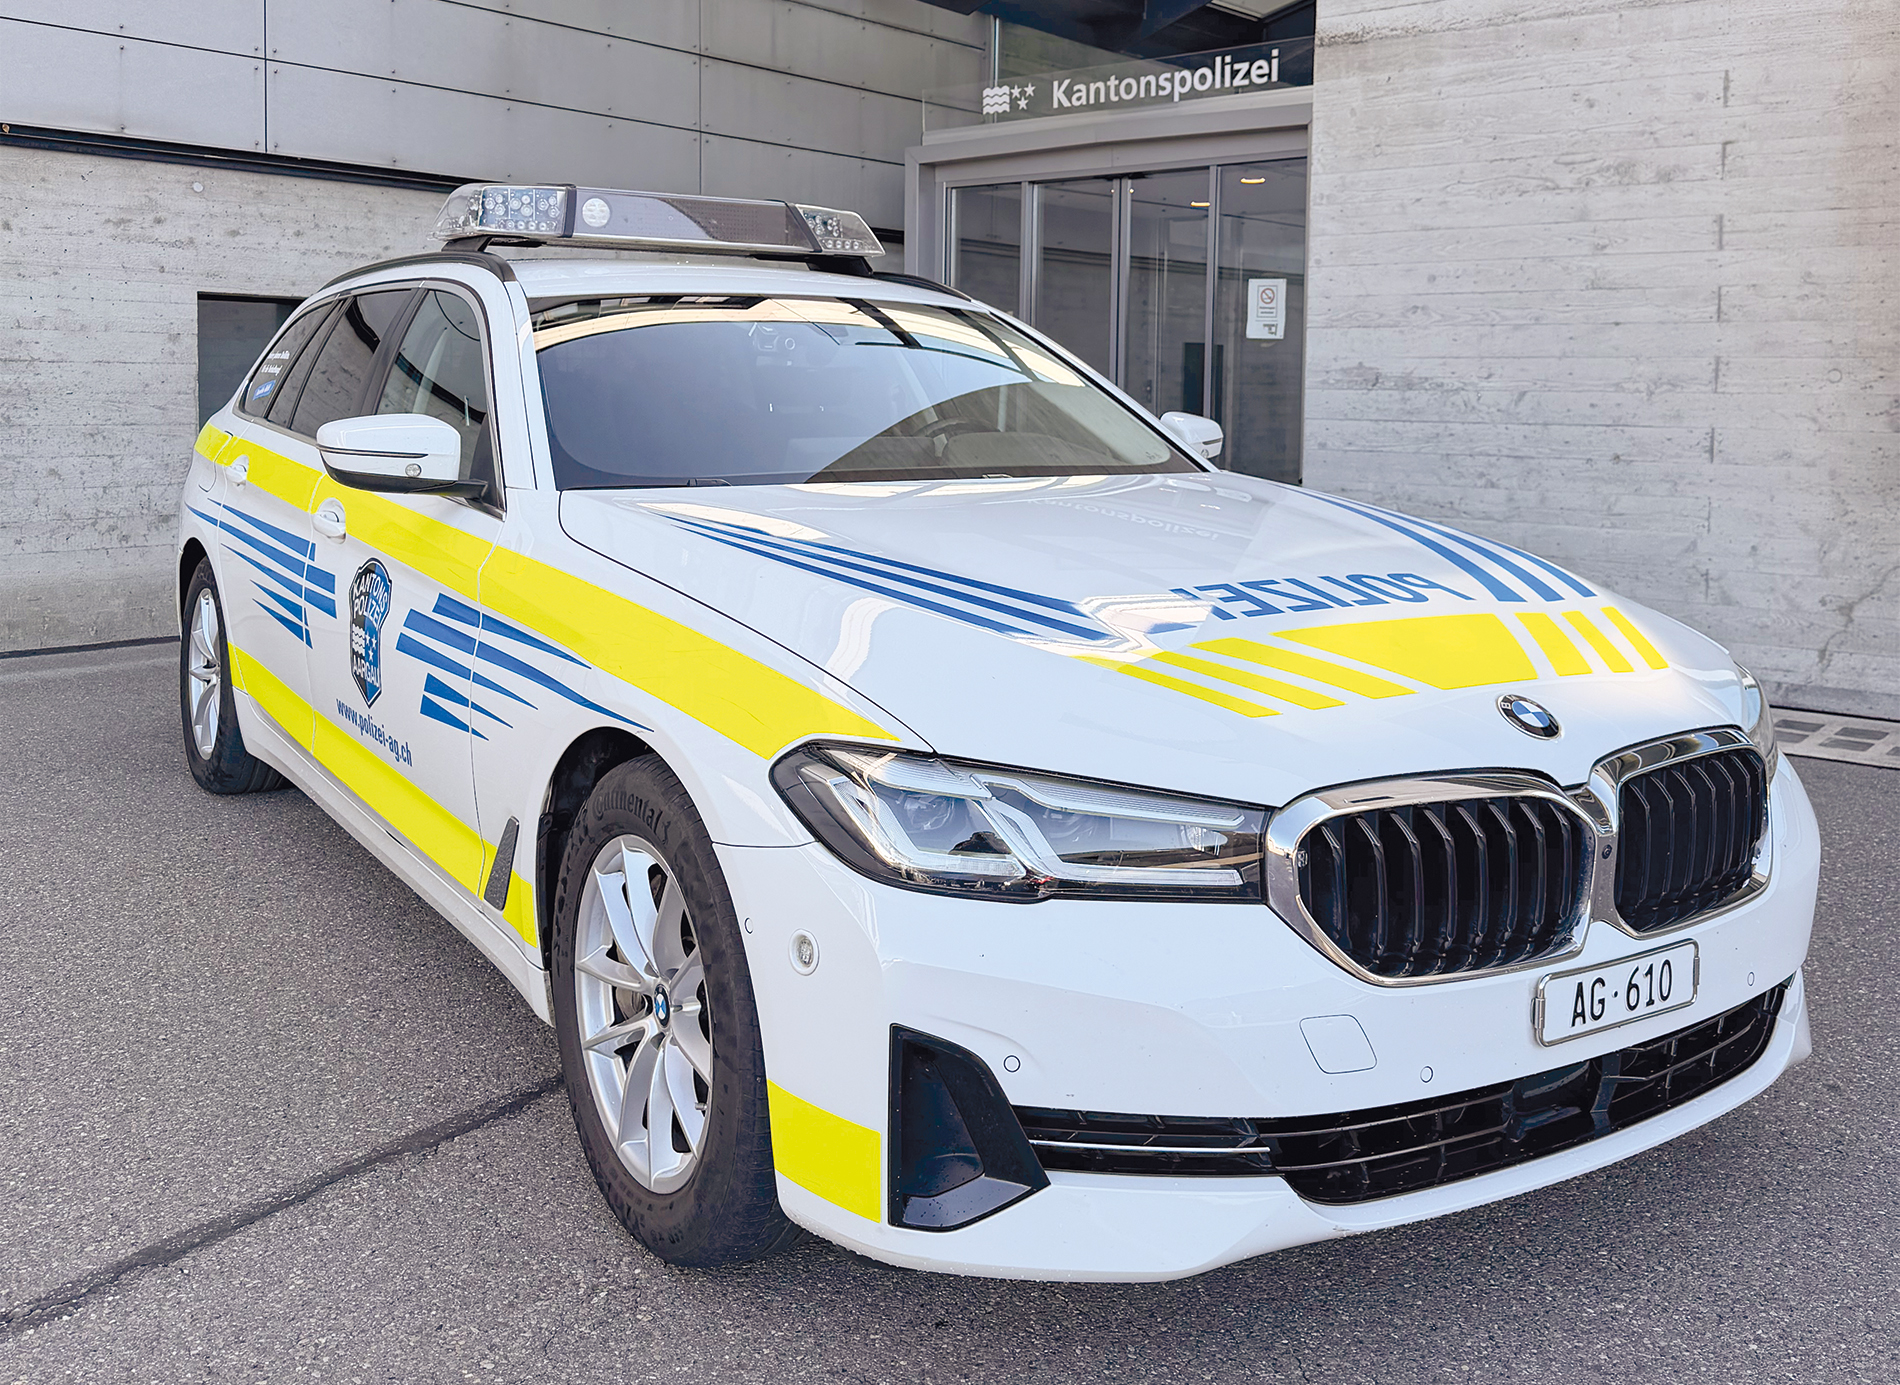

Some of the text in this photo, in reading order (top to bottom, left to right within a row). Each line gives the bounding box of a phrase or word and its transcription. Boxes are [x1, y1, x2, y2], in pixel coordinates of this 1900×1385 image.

[1052, 48, 1280, 109] Kantonspolizei
[353, 573, 388, 613] KANTONS
[353, 595, 382, 631] POLIZEI
[353, 655, 380, 687] AARGAU
[336, 698, 413, 767] www.polizei-ag.ch
[591, 788, 663, 835] Continental
